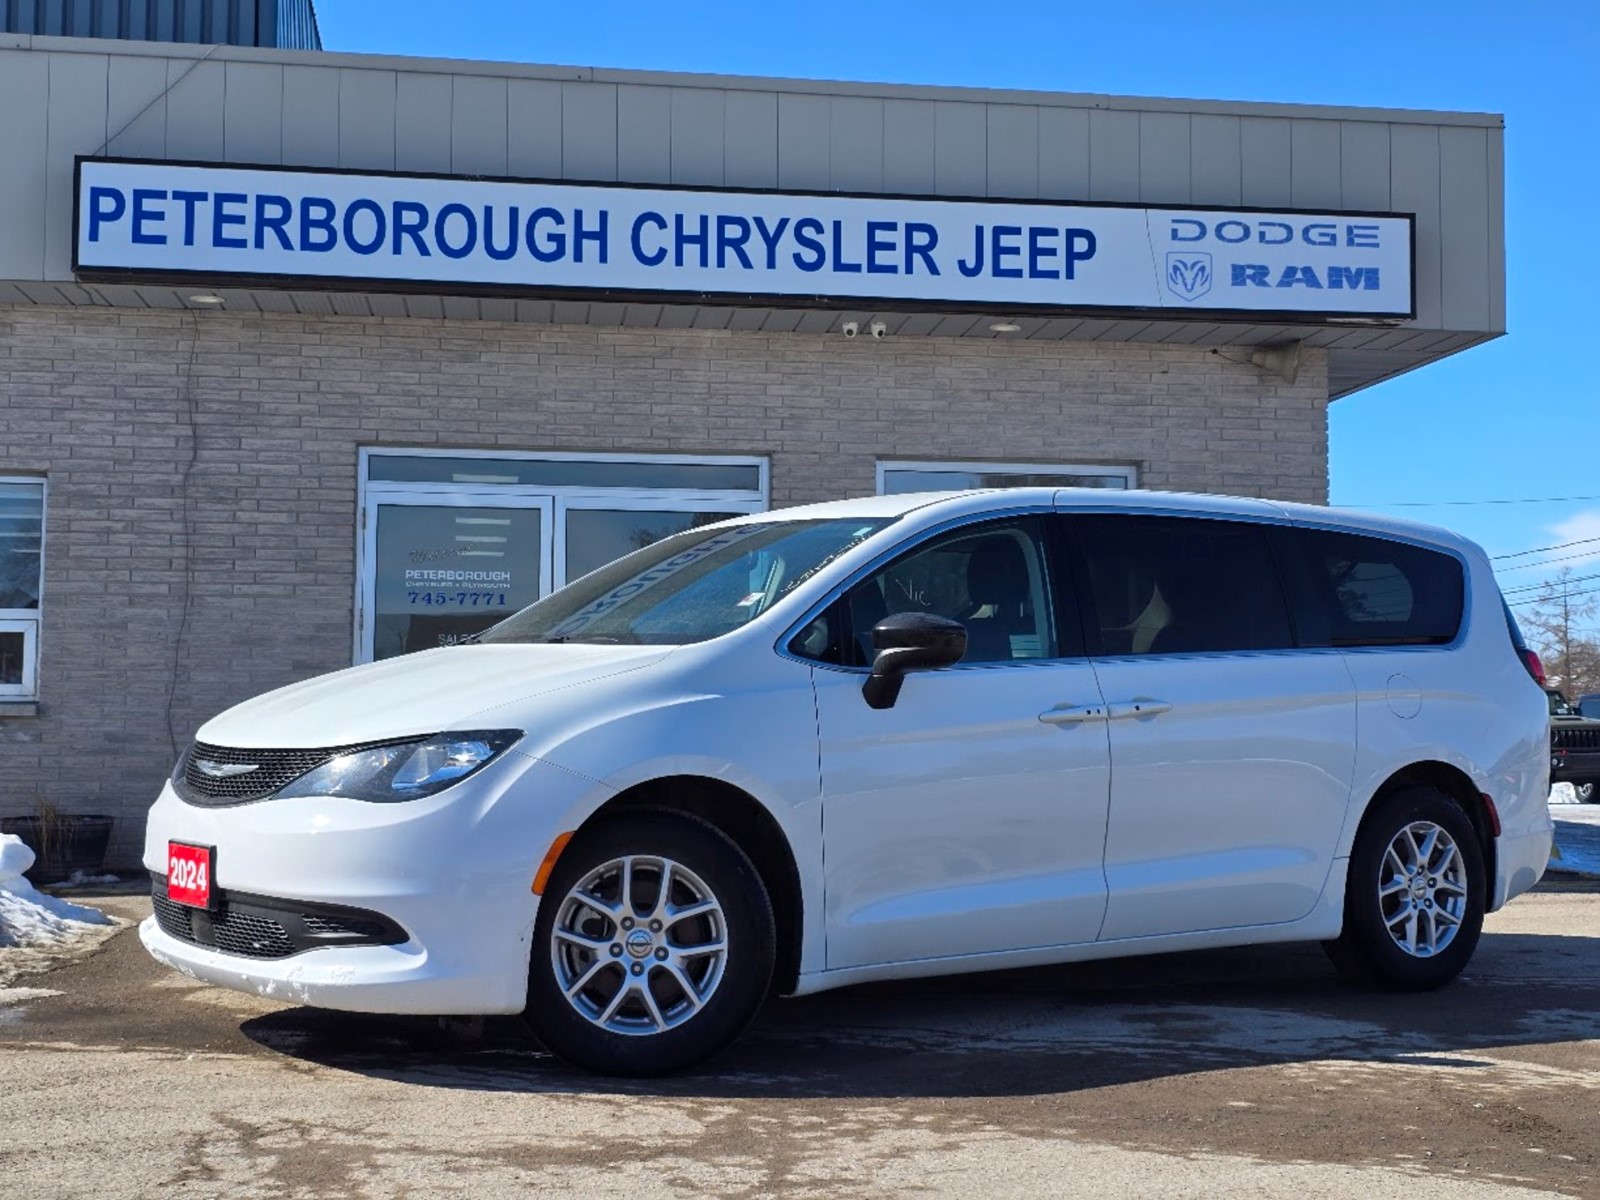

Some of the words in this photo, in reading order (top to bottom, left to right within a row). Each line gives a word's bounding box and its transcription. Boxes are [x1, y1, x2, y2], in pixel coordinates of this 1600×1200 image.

[88, 186, 609, 264] PETERBOROUGH
[630, 211, 941, 277] CHRYSLER
[957, 223, 1096, 281] JEEP
[1171, 219, 1380, 248] DODGE
[1231, 263, 1380, 290] RAM
[405, 569, 510, 581] PETERBOROUGH
[408, 591, 506, 606] 745-7771
[171, 856, 207, 891] 2024
